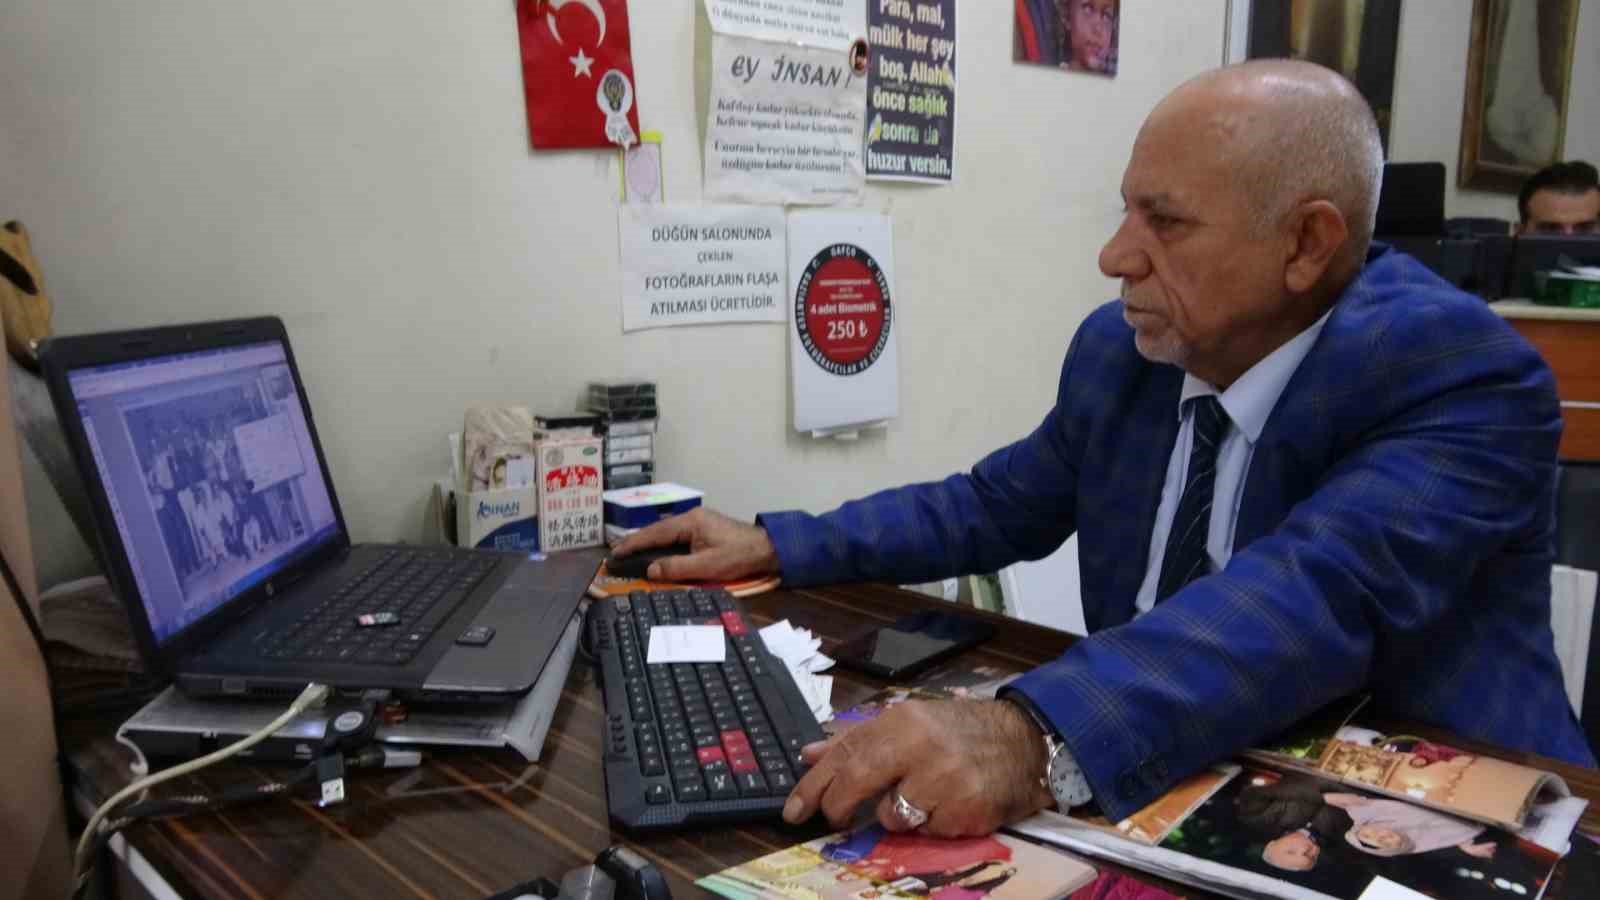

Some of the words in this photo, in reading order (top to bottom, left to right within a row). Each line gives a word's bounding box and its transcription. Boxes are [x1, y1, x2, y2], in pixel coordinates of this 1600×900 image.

[880, 0, 914, 24] Para,
[916, 4, 945, 31] mal,
[870, 22, 904, 48] mülk
[906, 28, 929, 53] her
[931, 38, 954, 61] şey
[880, 55, 908, 84] boş.
[873, 86, 906, 112] önce
[909, 93, 947, 118] sağlık
[882, 121, 920, 144] sonra
[868, 147, 906, 172] huzur
[909, 152, 951, 176] versin.
[652, 224, 698, 242] DÜĞÜN
[701, 226, 772, 241] SALONUNDA
[697, 249, 734, 264] ÇEKİLEN
[645, 271, 744, 291] FOTOĞRAFLARIN
[746, 271, 780, 289] FLAŞA
[650, 300, 708, 317] ATILMASI
[810, 303, 817, 314] 4
[818, 303, 837, 315] adet
[827, 320, 855, 340] 250
